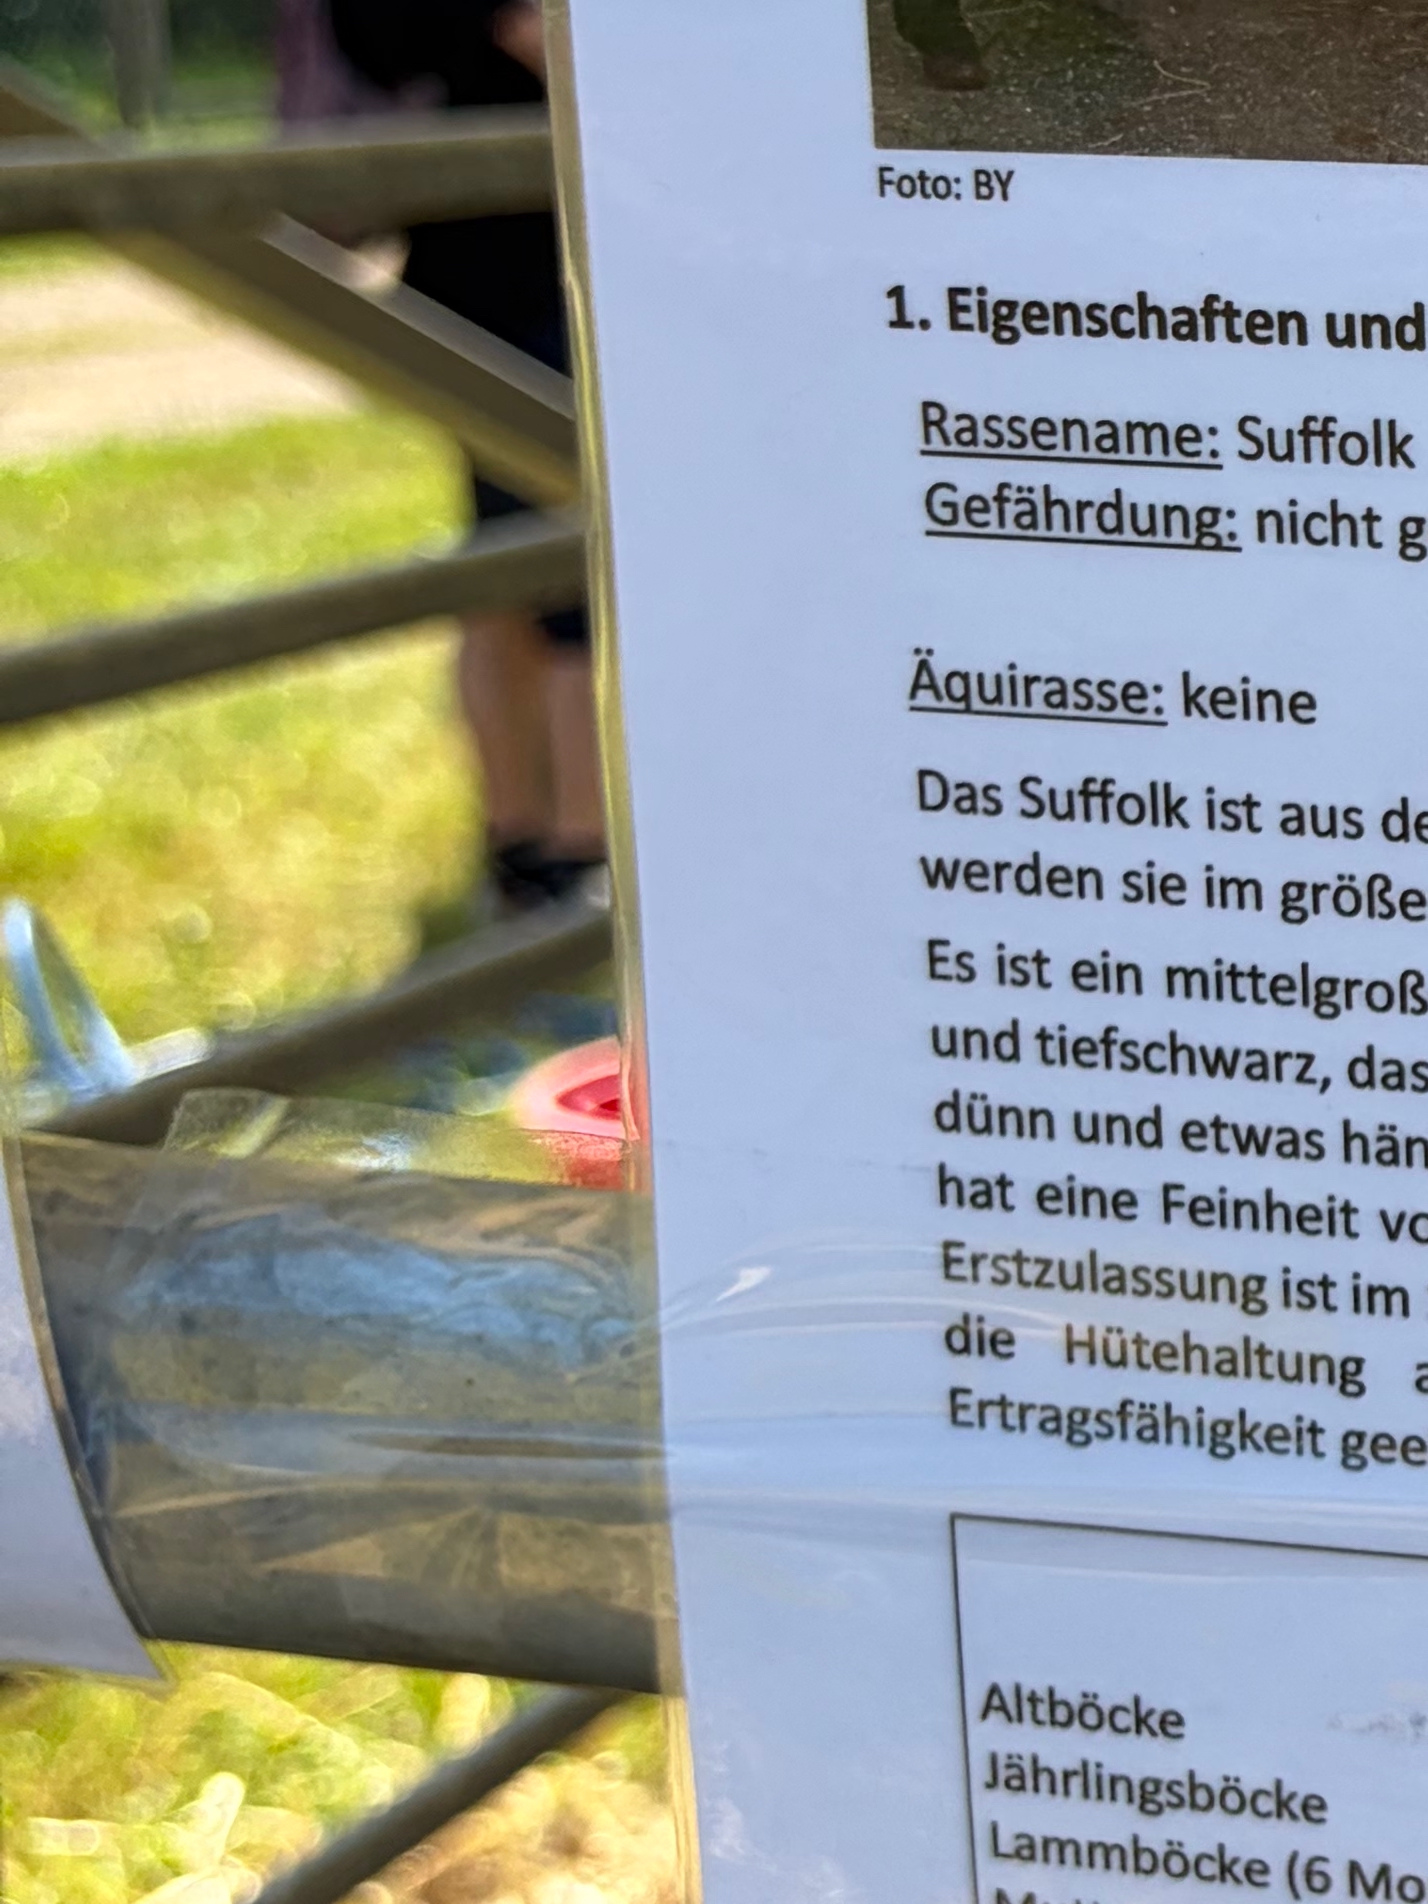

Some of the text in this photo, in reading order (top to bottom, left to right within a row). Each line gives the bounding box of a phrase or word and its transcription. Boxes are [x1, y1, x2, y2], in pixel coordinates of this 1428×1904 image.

[877, 165, 1015, 202] Foto: BY
[885, 284, 932, 332] 1.
[946, 285, 1309, 347] Eigenschaften
[1324, 300, 1427, 352] und
[920, 400, 1416, 470] Rassename: Suffolk
[924, 481, 1243, 554] Gefährdung:
[1255, 498, 1384, 550] nicht
[908, 646, 1317, 728] Äquirasse: keine
[916, 768, 1004, 817] Das
[1018, 775, 1191, 830] Suffolk
[1205, 785, 1263, 834] ist
[1279, 802, 1365, 841] aus
[918, 850, 1104, 901] werden
[1121, 859, 1188, 907] sie
[1204, 863, 1264, 913] im
[926, 938, 977, 984] Es
[996, 941, 1053, 990] ist
[1070, 949, 1144, 997] ein
[937, 1161, 1016, 1213] hat
[1035, 1173, 1139, 1222] eine
[1161, 1181, 1361, 1240] Feinheit
[948, 1386, 1327, 1461] Ertragsfähigkeit
[979, 1682, 1186, 1741] Altböcke
[984, 1751, 1328, 1825] Jährlingsböcke
[990, 1820, 1271, 1889] Lammböcke
[1286, 1849, 1333, 1902] (6
